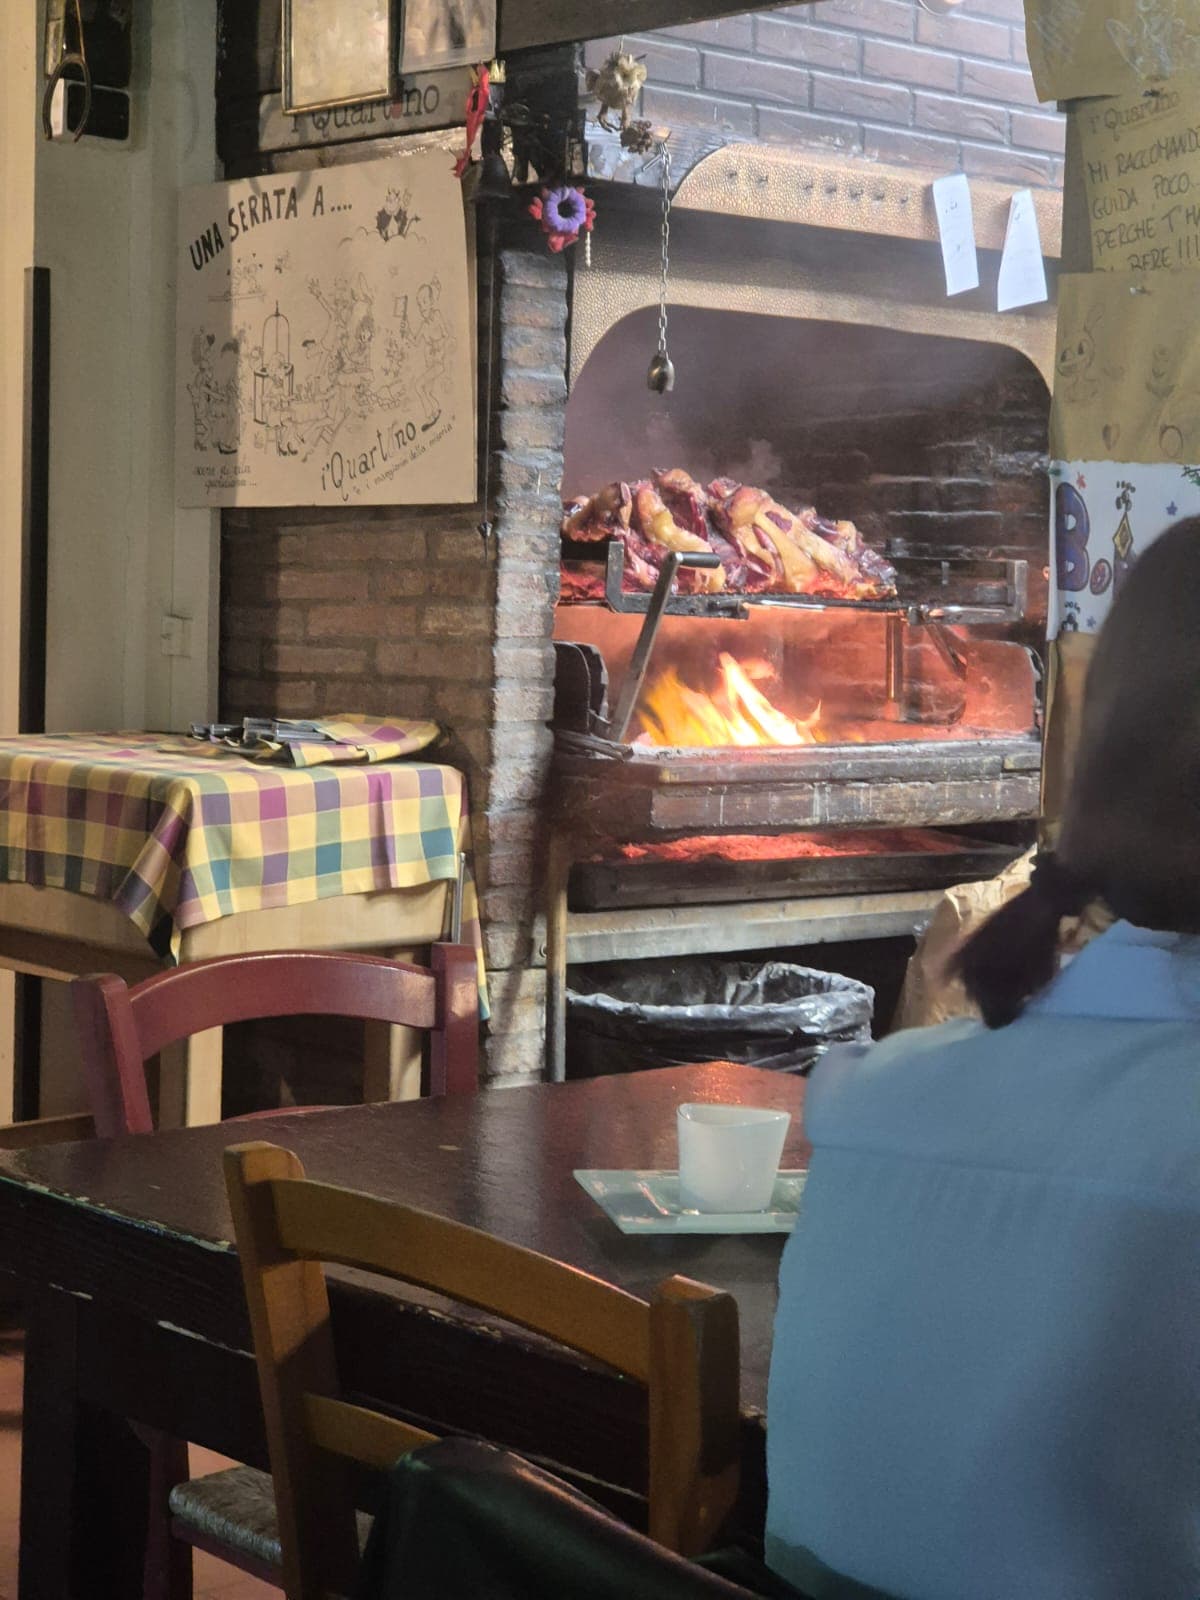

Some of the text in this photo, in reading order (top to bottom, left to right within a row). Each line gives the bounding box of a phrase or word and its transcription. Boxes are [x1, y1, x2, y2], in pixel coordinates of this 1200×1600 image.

[189, 222, 225, 271] UNA
[228, 187, 298, 243] SERATA
[1093, 172, 1189, 220] GUIDA POCO
